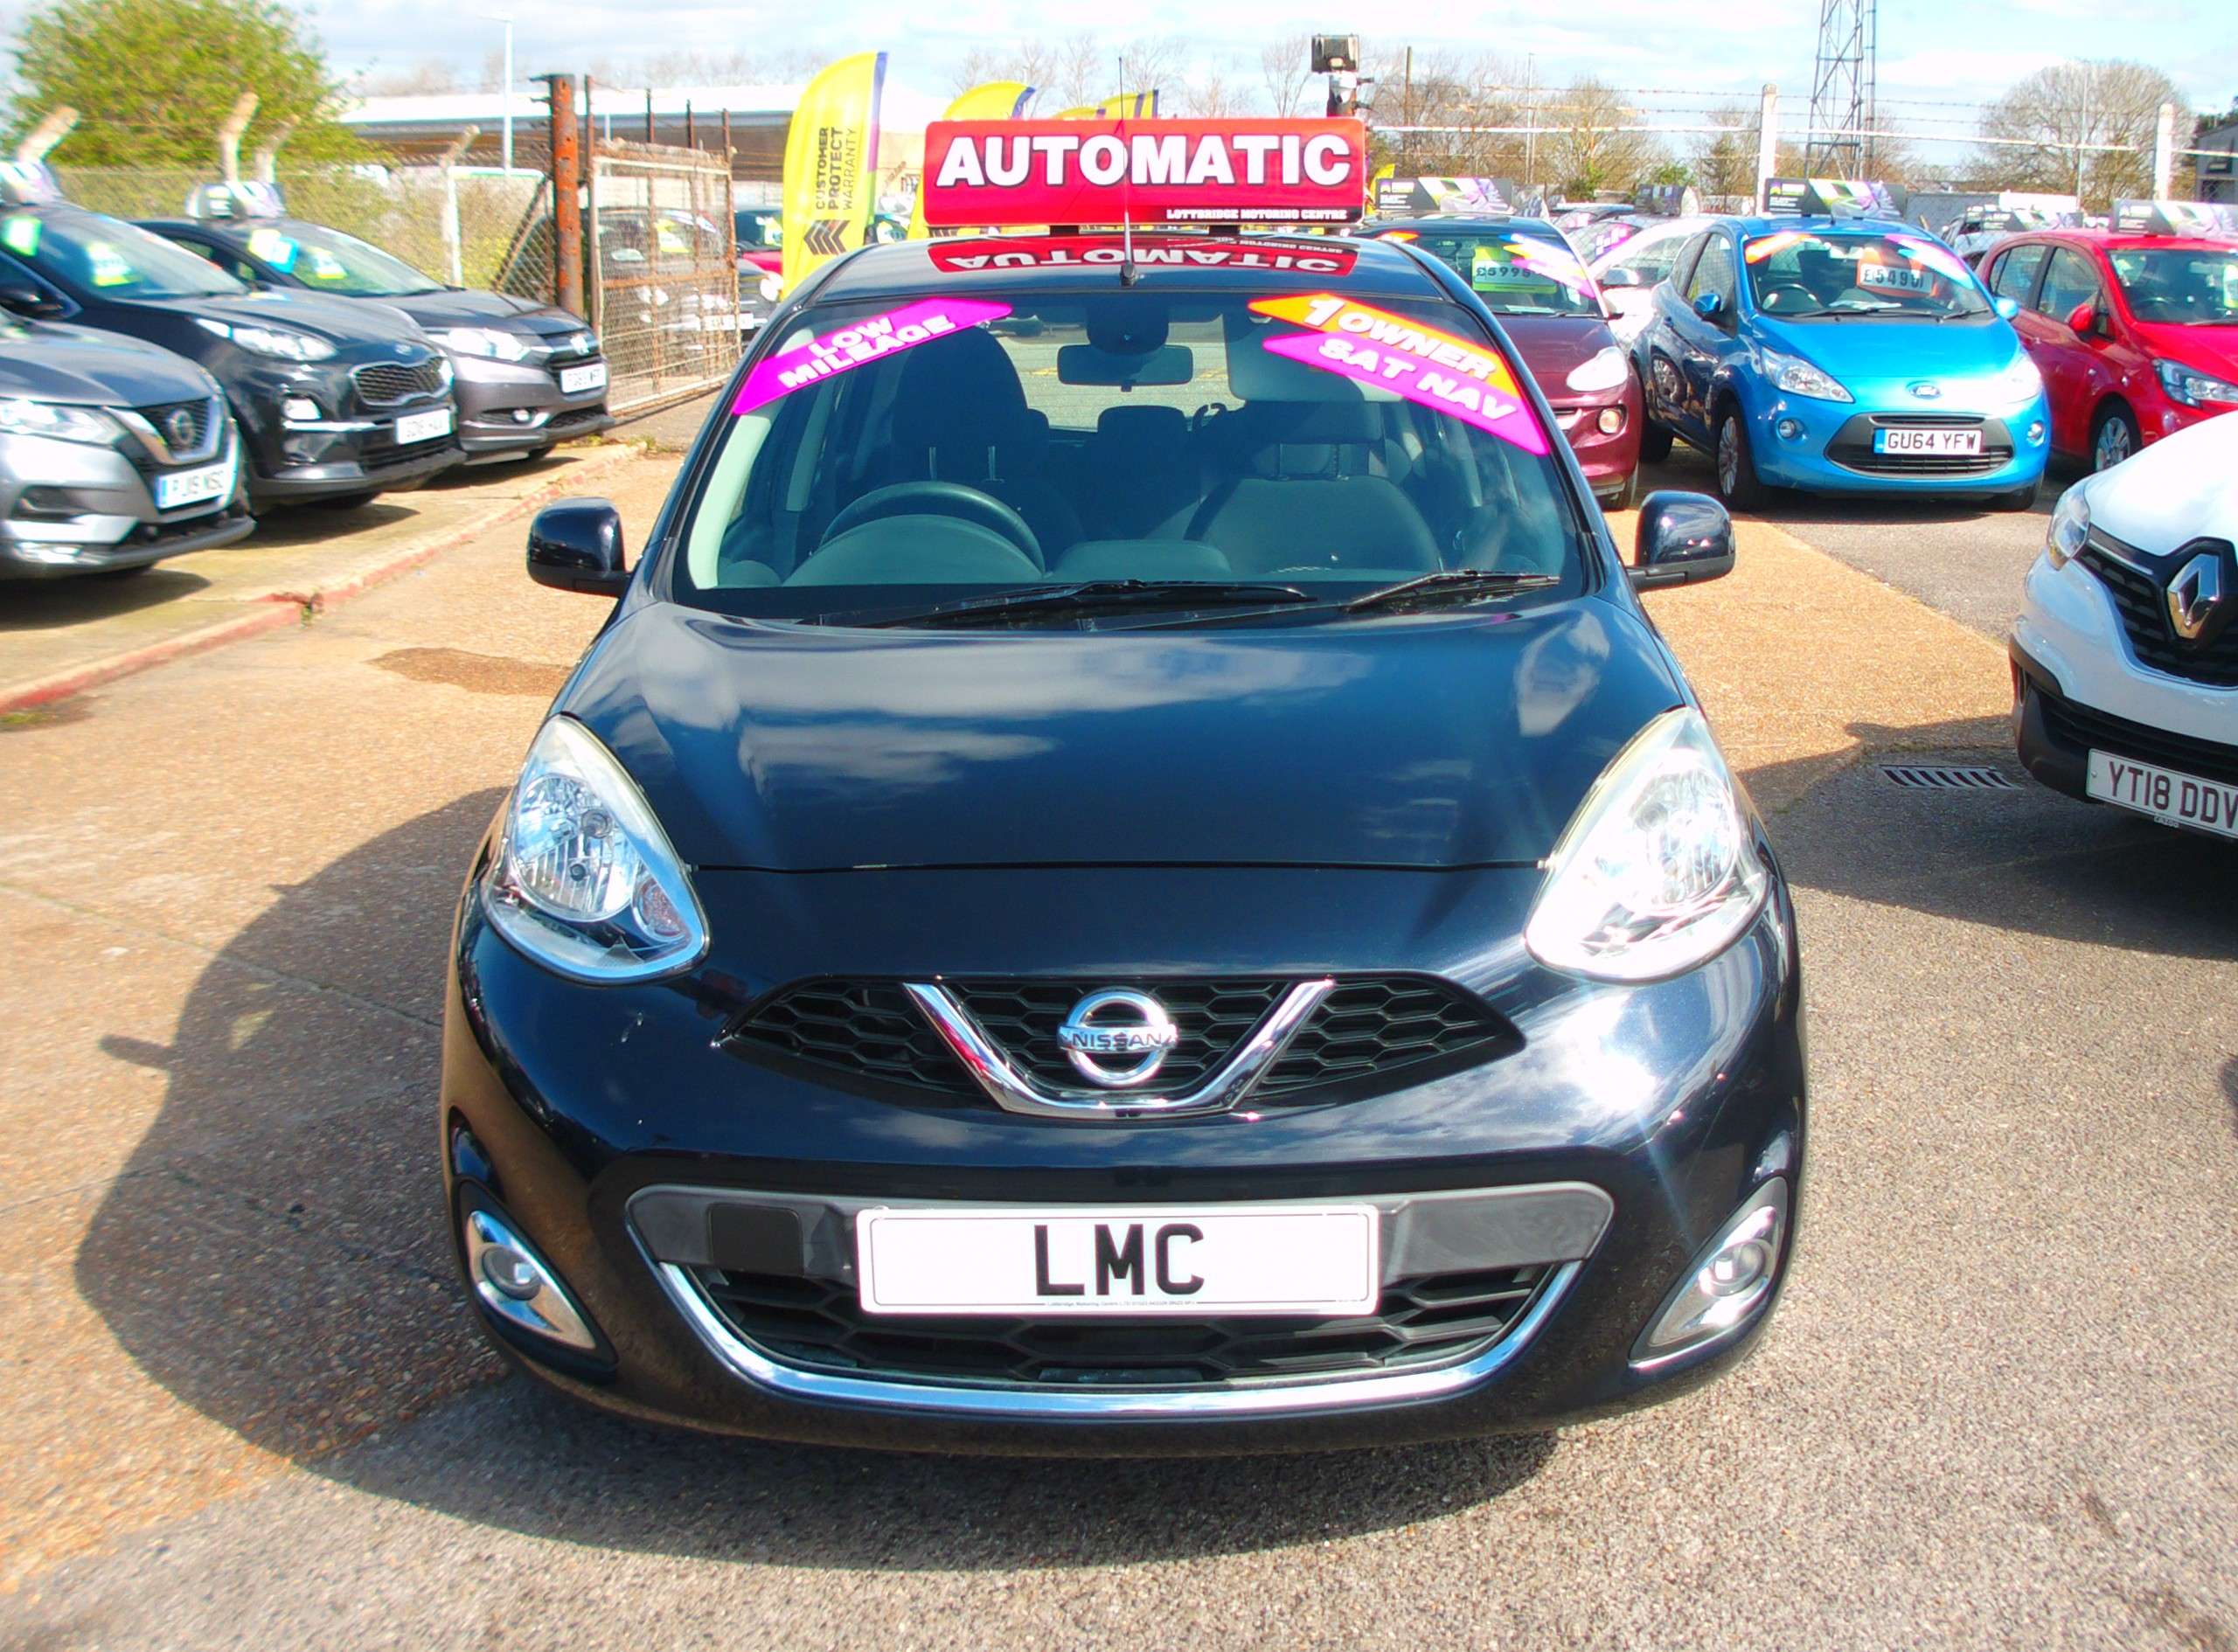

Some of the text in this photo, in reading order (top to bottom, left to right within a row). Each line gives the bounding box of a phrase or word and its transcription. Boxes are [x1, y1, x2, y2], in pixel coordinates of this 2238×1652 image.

[815, 127, 829, 210] CUSTOMER
[828, 127, 844, 210] PROTECT
[843, 128, 856, 210] WARRANTY
[935, 134, 1351, 187] AUTOMATIC
[1301, 209, 1347, 219] CENTRE
[777, 314, 956, 388] MILEAGE
[808, 316, 895, 358] LOW
[1302, 298, 1497, 380] 1 OWNER
[1318, 337, 1517, 420] SAT NAV
[1887, 433, 1977, 449] GU64 YFW
[2109, 760, 2238, 829] YT18 DDV
[1072, 1033, 1162, 1048] NISSAN
[1034, 1223, 1205, 1296] LMC
